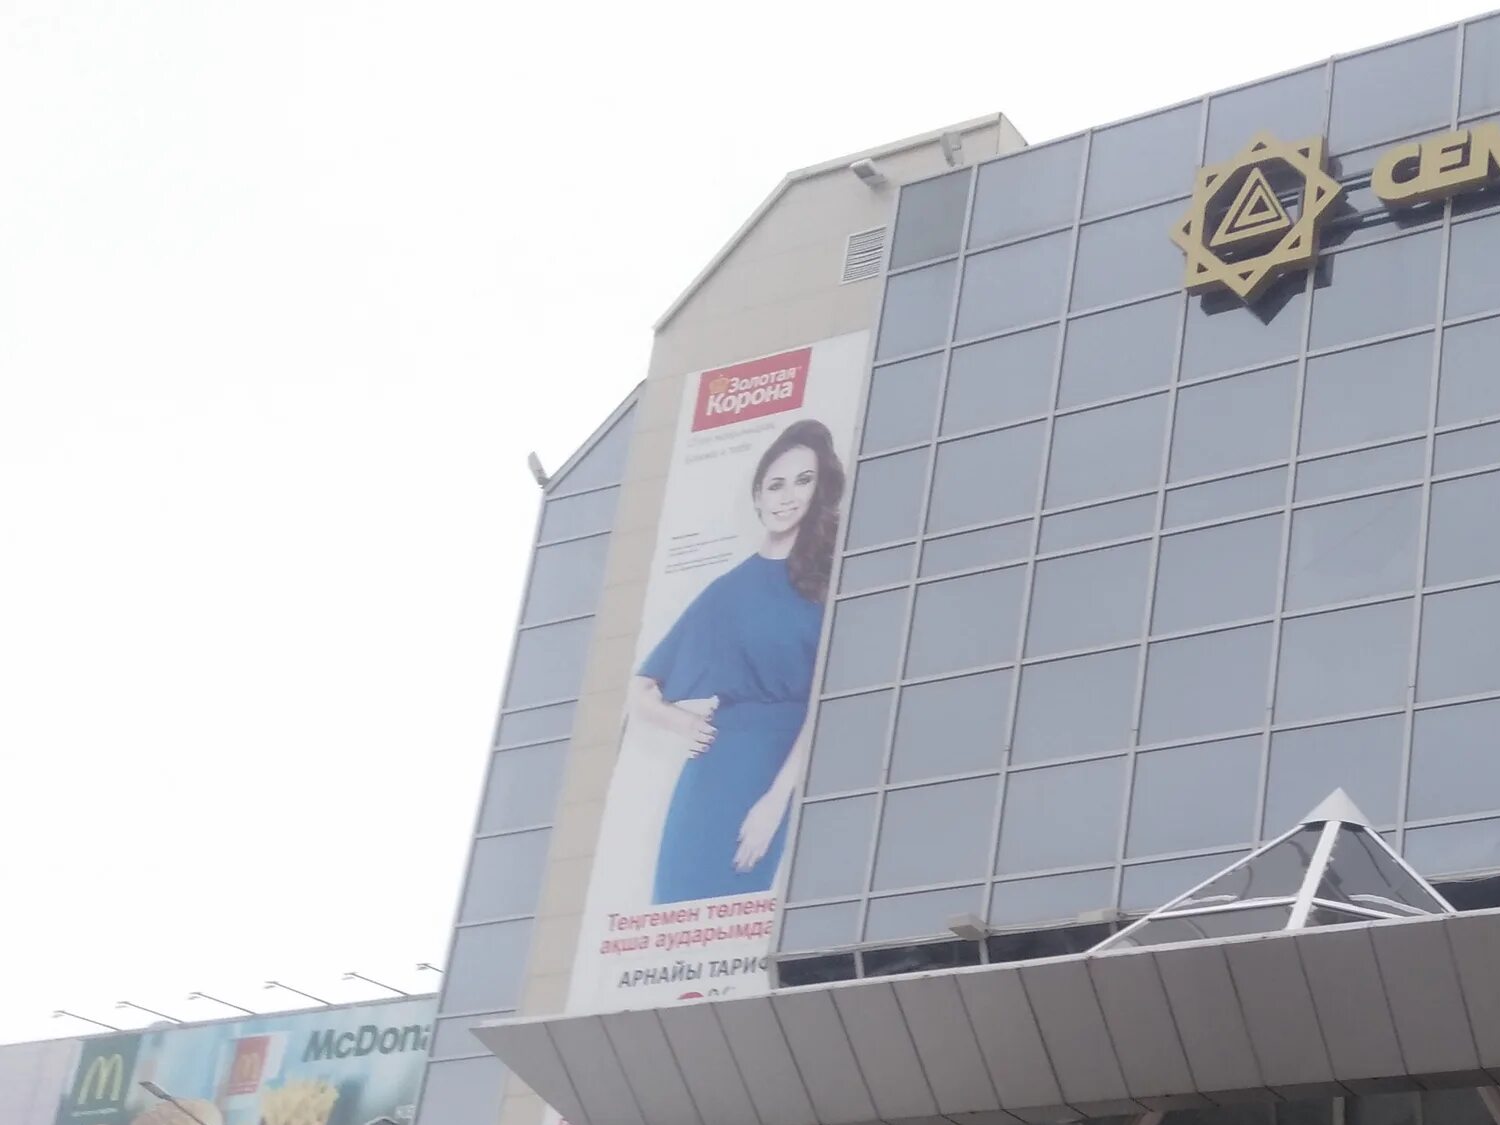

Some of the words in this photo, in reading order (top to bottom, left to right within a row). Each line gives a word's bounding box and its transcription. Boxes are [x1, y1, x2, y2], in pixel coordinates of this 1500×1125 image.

[728, 367, 796, 393] Золотая
[705, 381, 793, 416] Корона
[617, 960, 702, 988] АРНАЙЫ
